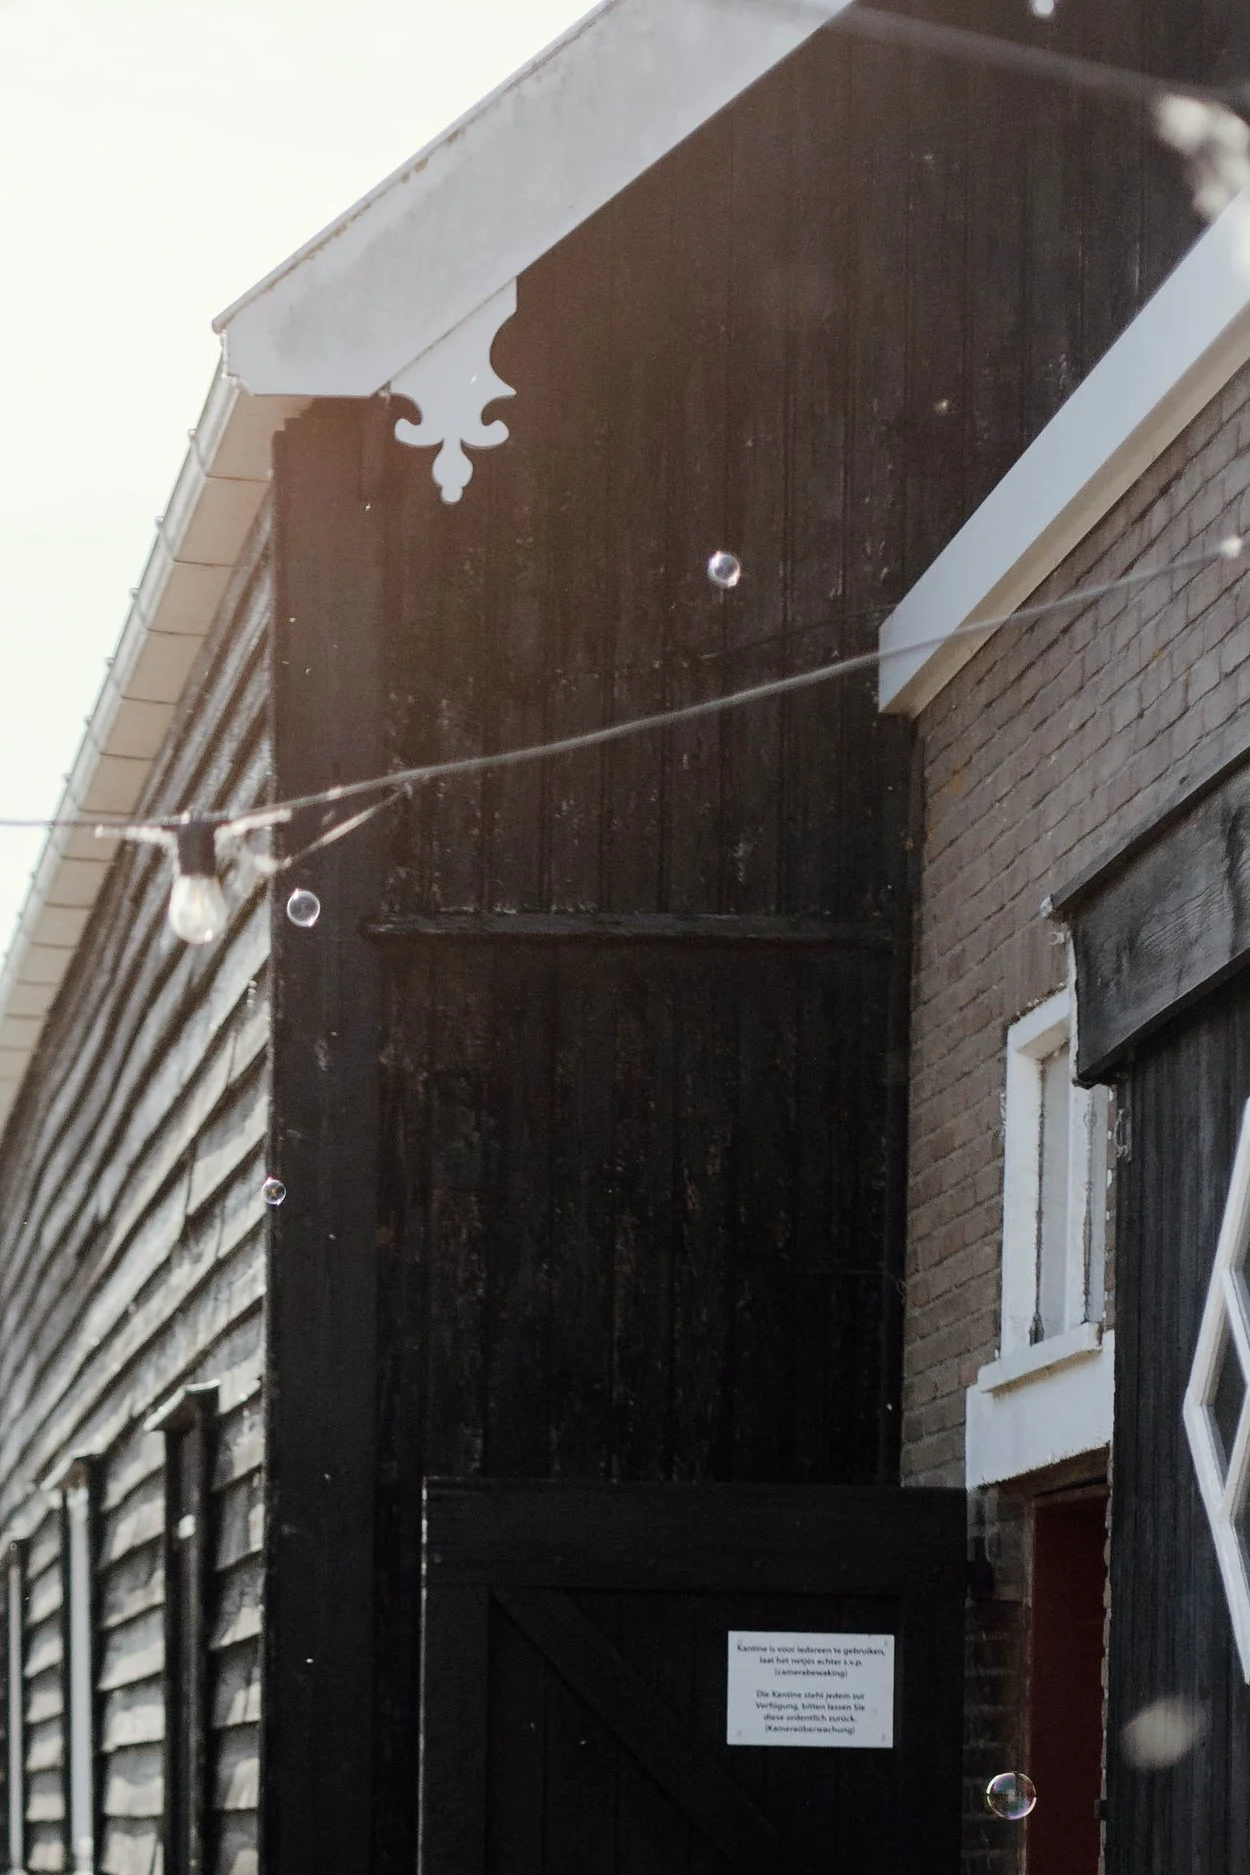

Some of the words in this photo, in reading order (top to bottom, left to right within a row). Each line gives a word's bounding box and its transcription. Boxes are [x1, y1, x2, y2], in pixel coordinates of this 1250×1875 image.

[737, 1644, 768, 1653] Kantine
[797, 1646, 832, 1654] iedereen
[759, 1656, 774, 1664] laat
[776, 1656, 789, 1664] het
[791, 1657, 815, 1666] netjes
[817, 1657, 841, 1665] achter
[756, 1690, 769, 1698] Die
[772, 1690, 802, 1699] Kantine
[804, 1691, 824, 1699] steht
[825, 1691, 851, 1701] jedem
[802, 1702, 826, 1710] bitten
[827, 1703, 852, 1711] lassen
[763, 1713, 785, 1721] diese
[786, 1714, 826, 1722] ordentlich
